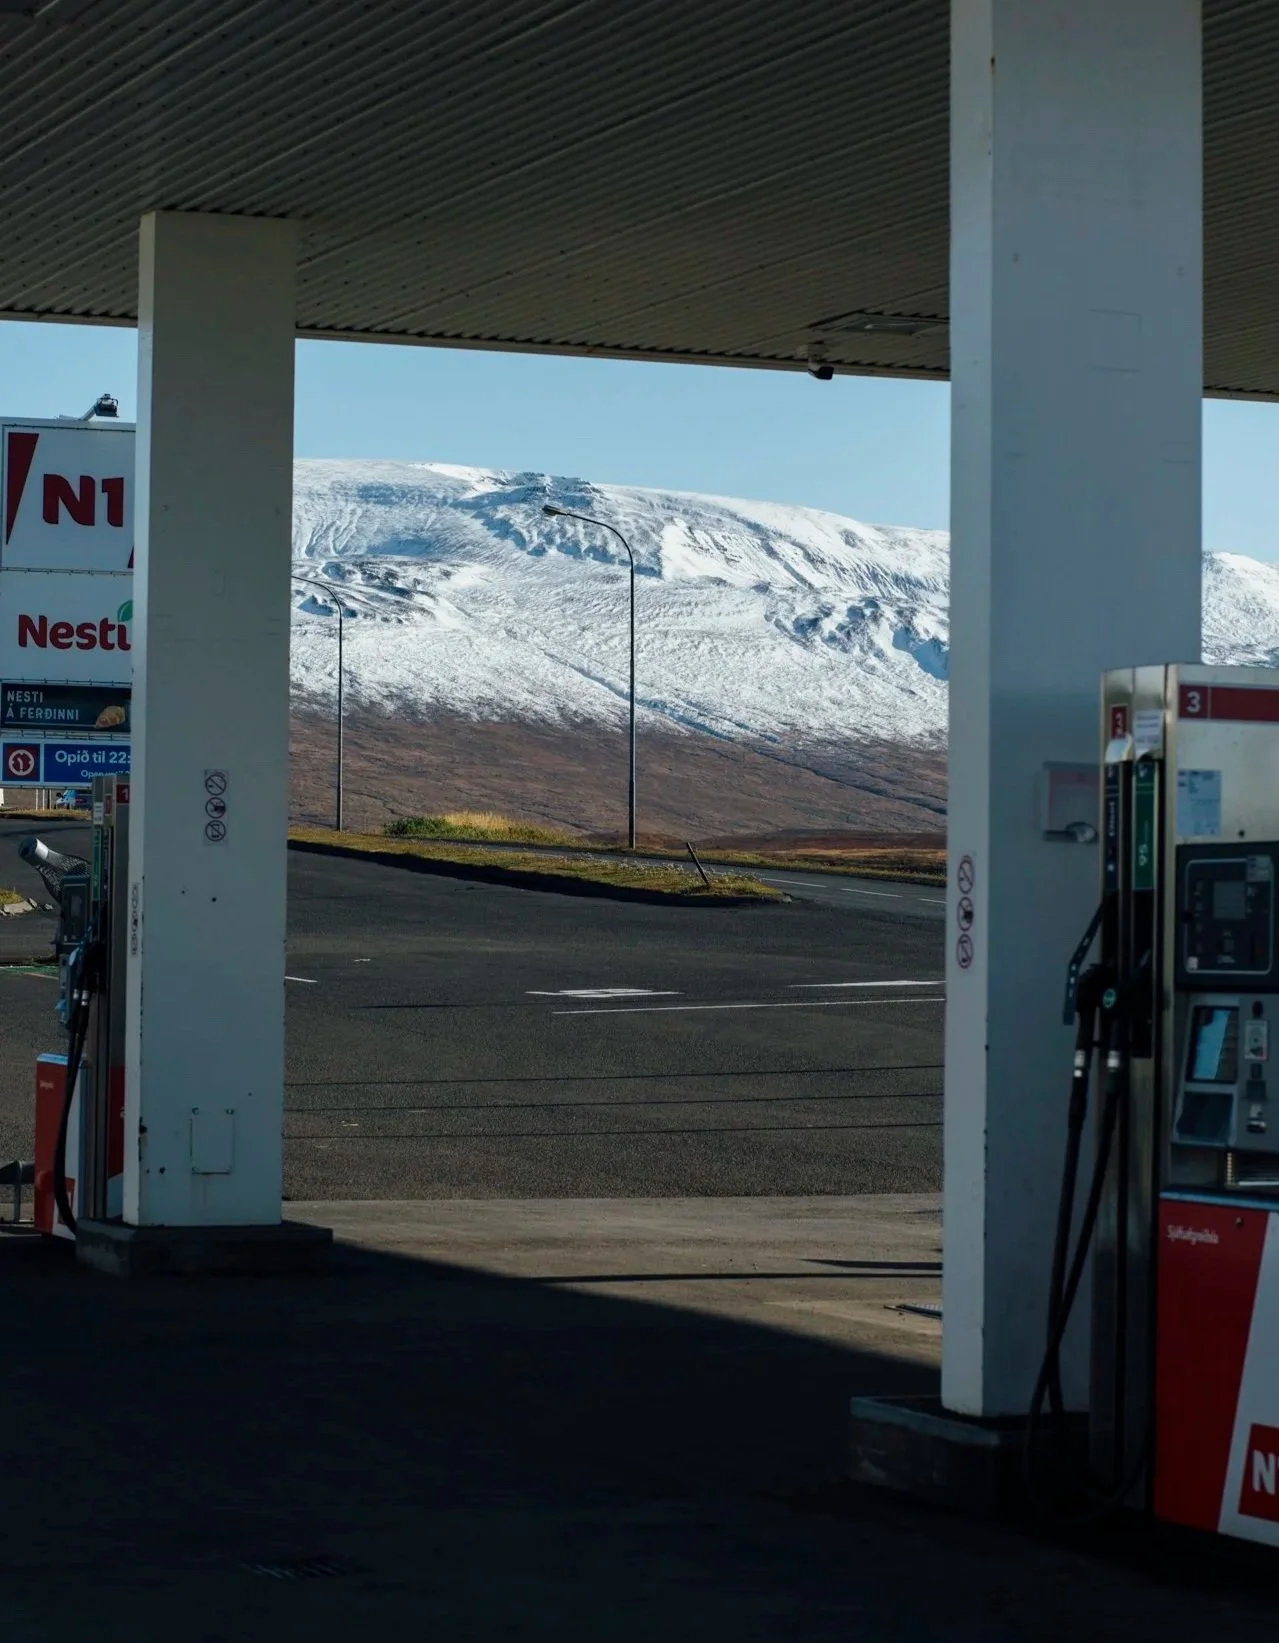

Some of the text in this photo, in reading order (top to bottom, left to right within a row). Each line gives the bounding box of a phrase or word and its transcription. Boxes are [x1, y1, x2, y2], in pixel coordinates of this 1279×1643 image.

[43, 474, 124, 528] N1
[18, 614, 131, 651] Nesti
[6, 690, 44, 703] NESTI
[1187, 691, 1201, 713] 3
[6, 703, 80, 721] Á FERÐINNI
[55, 750, 90, 767] Opið
[92, 750, 106, 764] til
[1252, 1449, 1279, 1496] N
